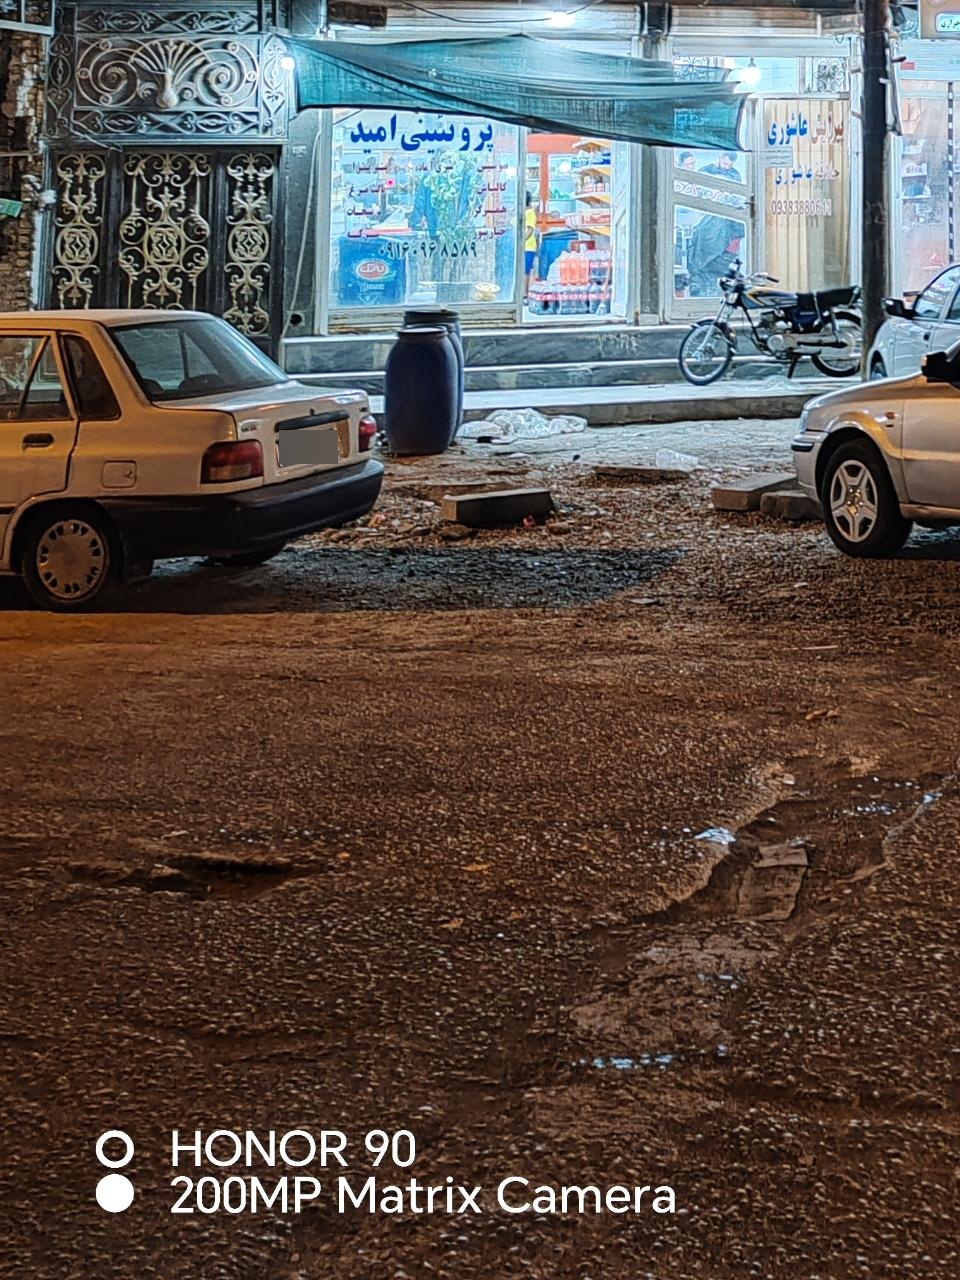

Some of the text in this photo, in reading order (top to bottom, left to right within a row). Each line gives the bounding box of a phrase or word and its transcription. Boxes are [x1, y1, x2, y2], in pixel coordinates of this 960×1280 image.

[350, 114, 397, 153] امید
[767, 112, 808, 145] عاشوری
[477, 182, 507, 195] کالباس
